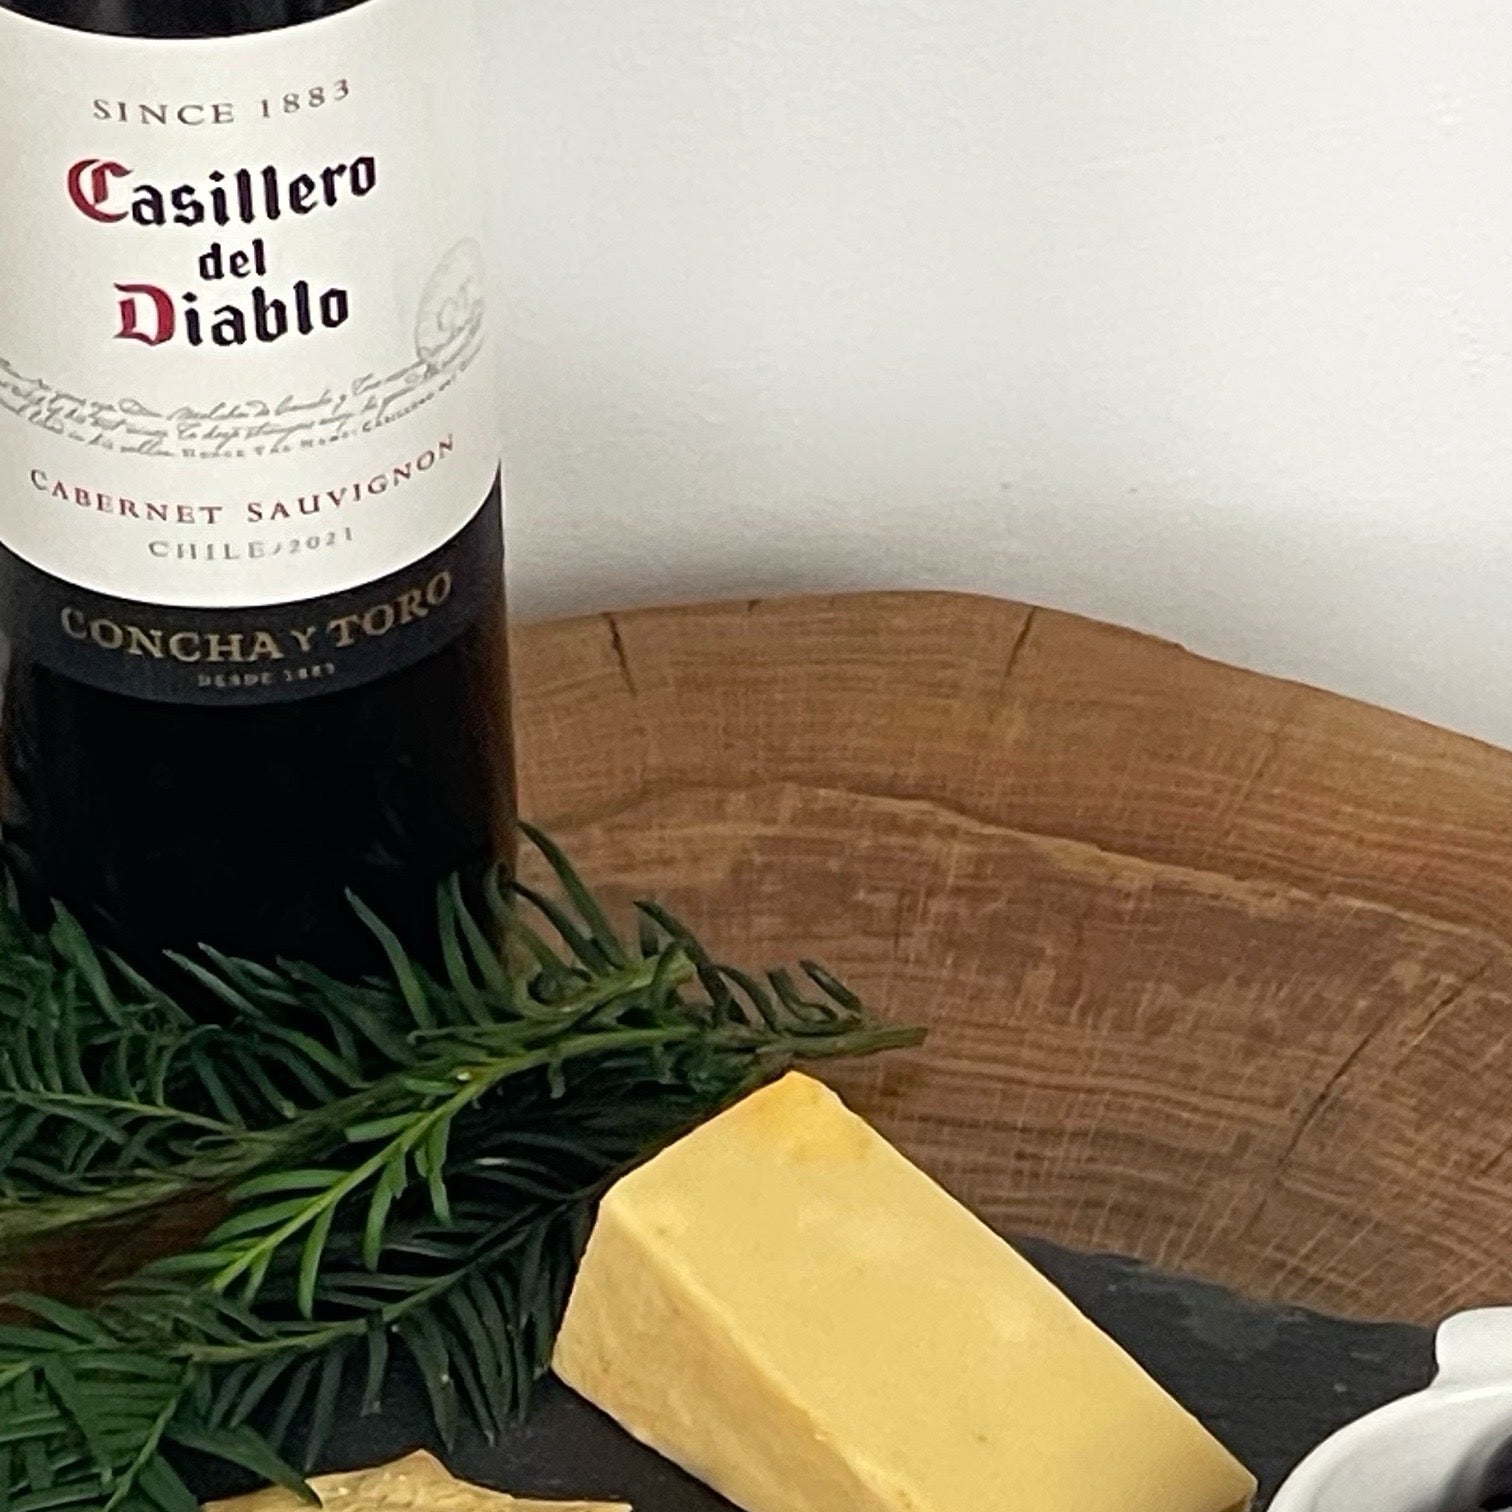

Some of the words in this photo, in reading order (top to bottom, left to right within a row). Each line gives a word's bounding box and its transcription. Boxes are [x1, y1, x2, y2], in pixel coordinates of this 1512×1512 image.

[92, 97, 235, 126] SINCE
[260, 78, 351, 120] 1883
[67, 155, 377, 227] Casillero
[198, 237, 267, 281] del
[113, 280, 349, 347] Diablo
[29, 468, 224, 526] CABERNET
[246, 432, 456, 524] SAUVIGNON
[60, 606, 285, 665] CONCHA
[326, 570, 453, 649] TORO
